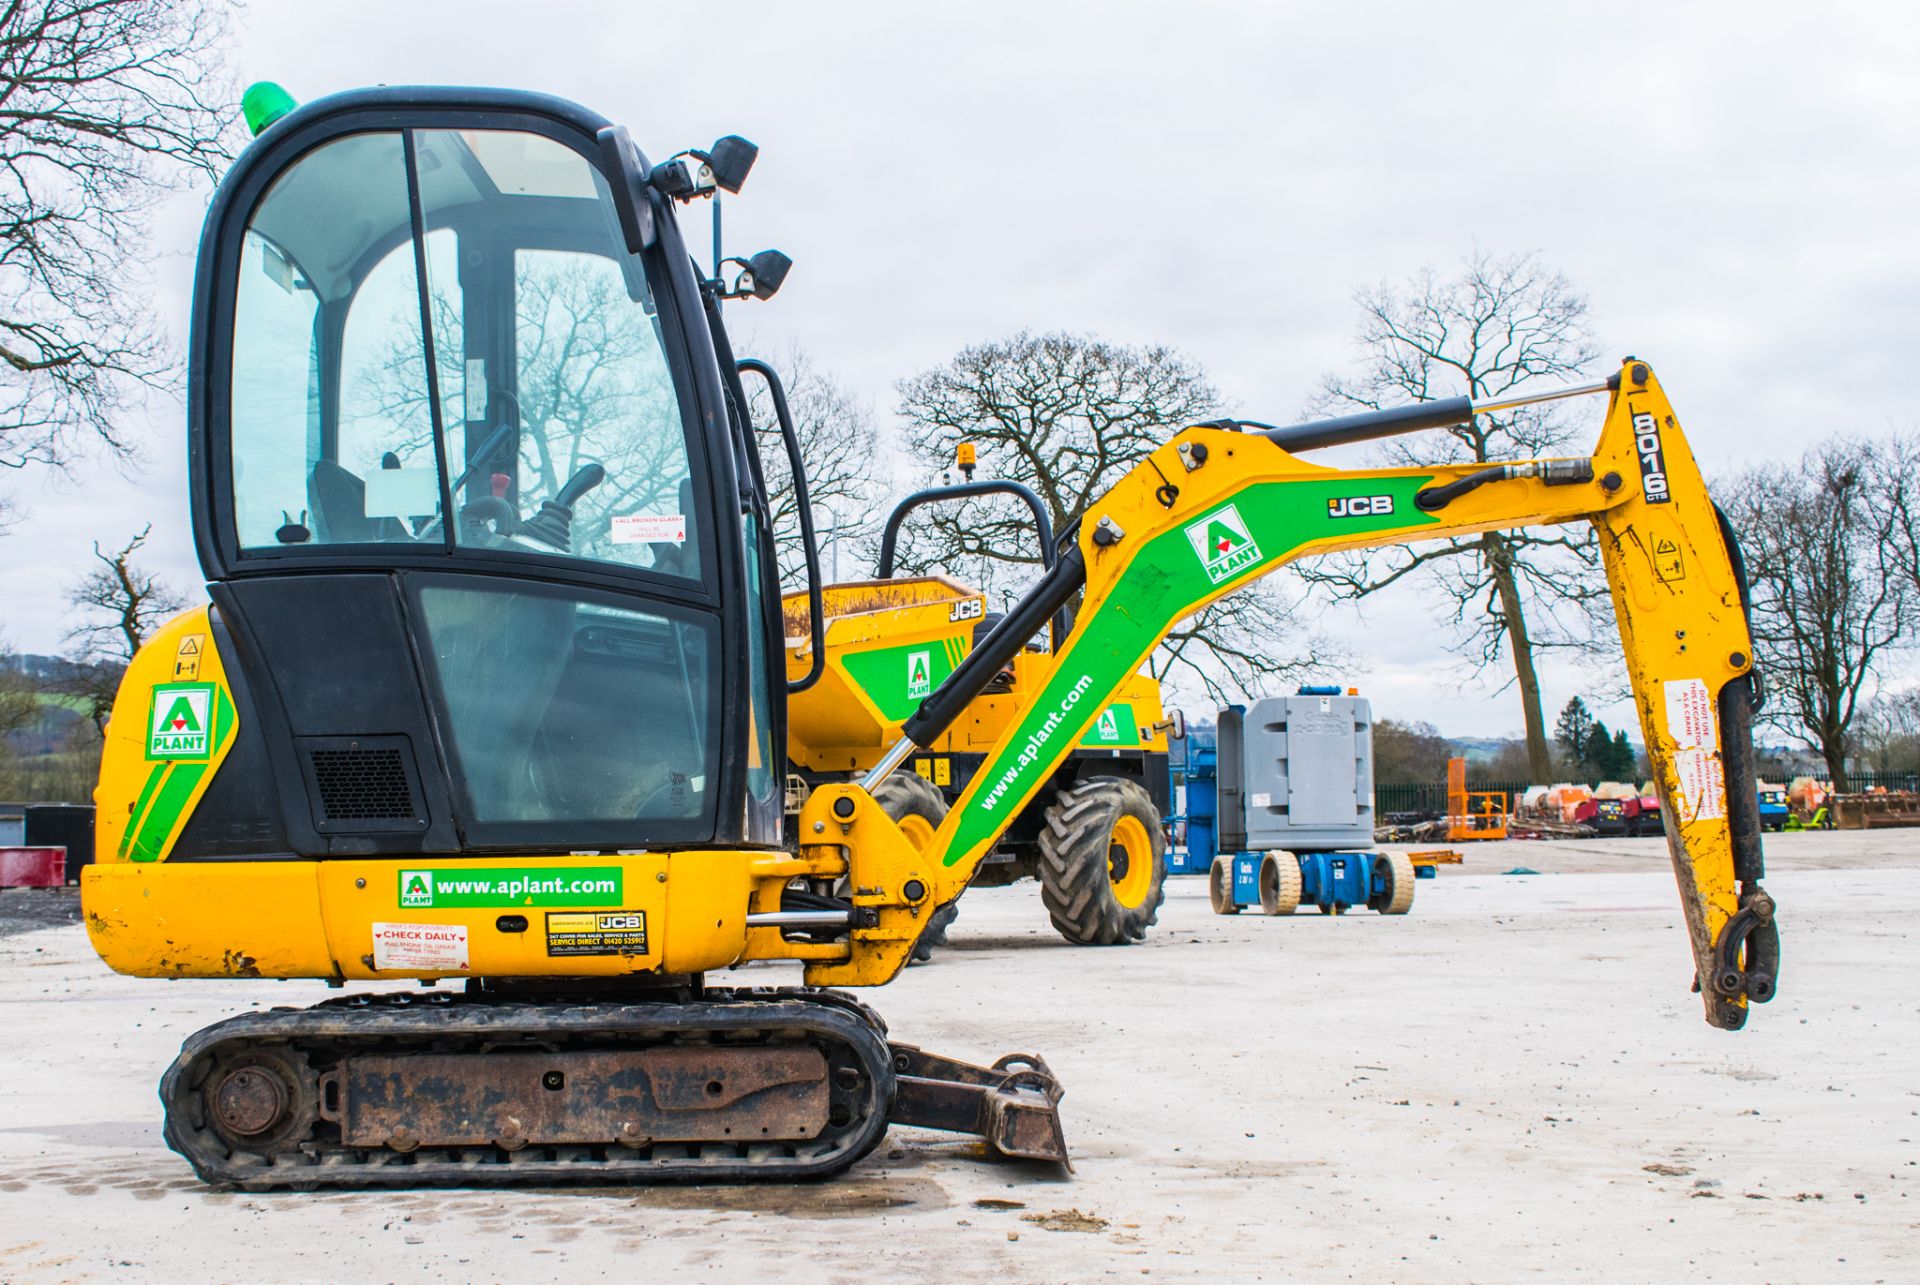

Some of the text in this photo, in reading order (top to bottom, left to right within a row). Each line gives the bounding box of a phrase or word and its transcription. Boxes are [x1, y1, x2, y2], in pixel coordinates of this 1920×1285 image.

[1633, 414, 1668, 494] 8016
[1328, 495, 1394, 518] JCB
[1646, 493, 1668, 501] CTS
[1208, 519, 1248, 562] A
[1208, 545, 1258, 581] PLANT
[949, 599, 982, 622] JCB
[911, 657, 928, 683] A
[909, 684, 929, 696] PLANT
[1699, 690, 1706, 701] DO
[158, 696, 201, 732] A
[1684, 710, 1692, 736] CRANE
[1690, 682, 1702, 747] THIS EXCAVATOR
[153, 736, 204, 750] PLANT
[981, 675, 1094, 811] www.aplant.com
[406, 875, 429, 895] A
[436, 876, 616, 899] www.aplant.com
[402, 896, 432, 904] PLANT
[600, 917, 640, 928] JCB
[383, 931, 457, 941] CHECK DAILY
